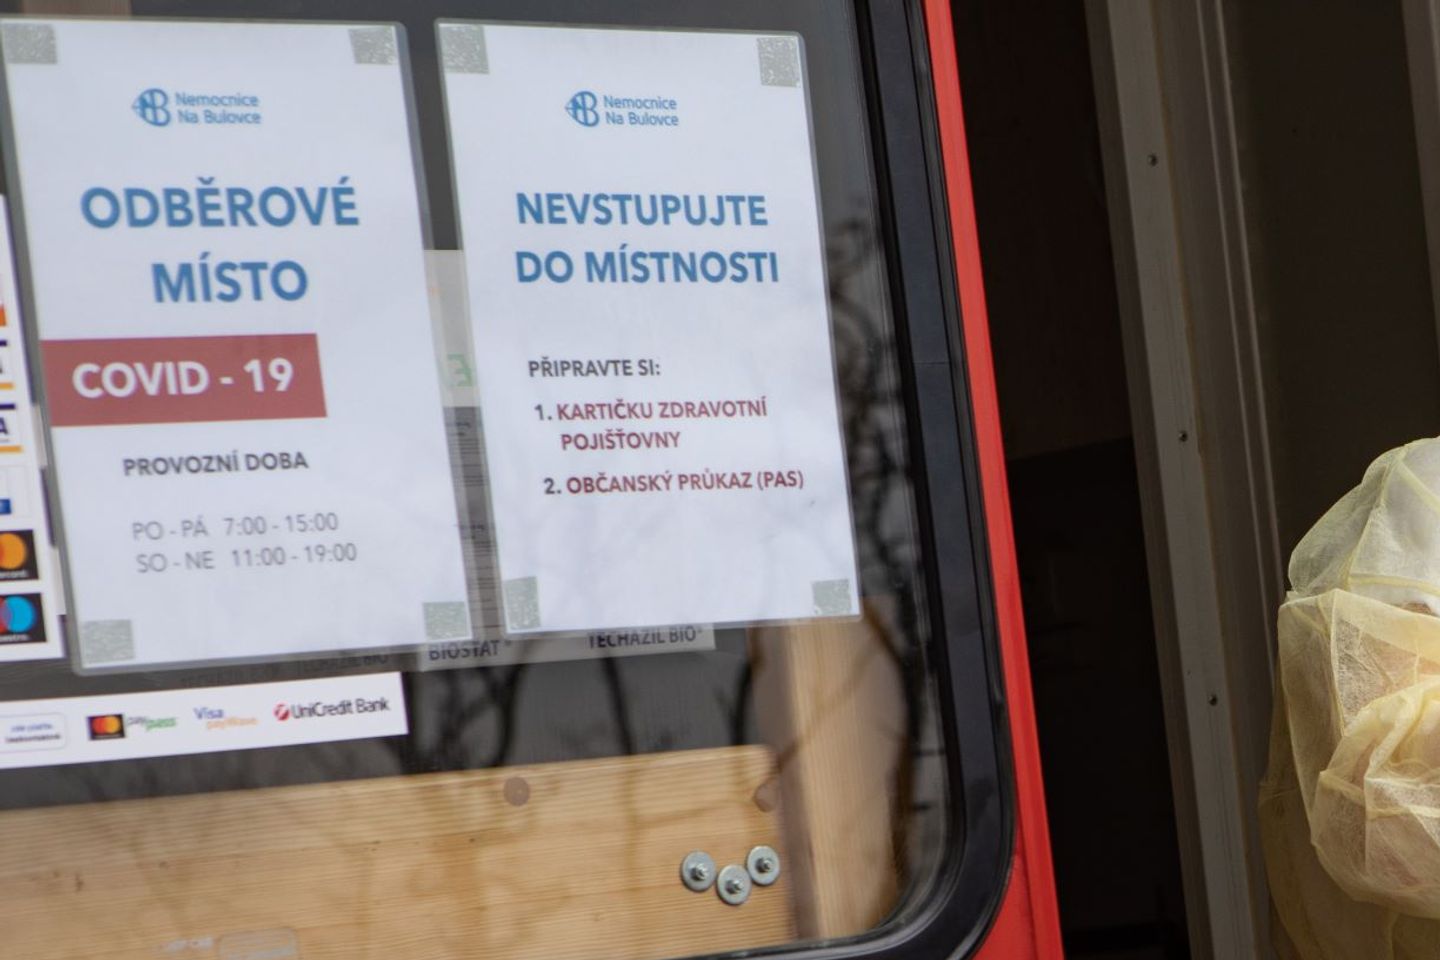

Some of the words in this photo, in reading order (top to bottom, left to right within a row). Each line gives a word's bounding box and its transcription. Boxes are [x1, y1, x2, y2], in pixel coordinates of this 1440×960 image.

[174, 92, 260, 108] Nemocnice
[602, 94, 678, 111] Nemocnice
[177, 109, 200, 124] Na
[203, 108, 262, 125] Bulovce
[605, 111, 625, 126] Na
[627, 111, 680, 127] Bulovce
[79, 175, 361, 230] ODBĚROVÉ
[515, 192, 769, 227] NEVSTUPUJTE
[515, 250, 574, 284] DO
[584, 243, 780, 284] MÍSTNOSTI
[150, 251, 309, 304] MÍSTO
[71, 359, 210, 399] COVID
[243, 357, 294, 393] 19
[527, 356, 634, 378] PŘIPRAVTE
[637, 358, 661, 377] SI:
[534, 403, 553, 421] 1.
[556, 398, 654, 421] KARTIČKU
[657, 395, 768, 419] ZDRAVOTNÍ
[560, 430, 681, 451] POJIŠŤOVNY
[122, 449, 240, 477] PROVOZNÍ
[244, 451, 310, 472] DOBA
[543, 477, 562, 495] 2.
[565, 470, 673, 495] OBČANSKÝ
[677, 468, 753, 491] PRŮKAZ
[756, 470, 805, 491] (PAS)
[131, 520, 166, 541] PO
[180, 515, 209, 538] PÁ
[223, 515, 268, 536] 7:00
[284, 511, 340, 533] 15:00
[135, 552, 168, 574] SO
[184, 550, 215, 570] NE
[231, 546, 286, 568] 11:00
[303, 542, 358, 563] 19:00
[193, 705, 225, 721] Visa
[291, 699, 354, 721] UniCredit
[355, 696, 391, 716] Bank
